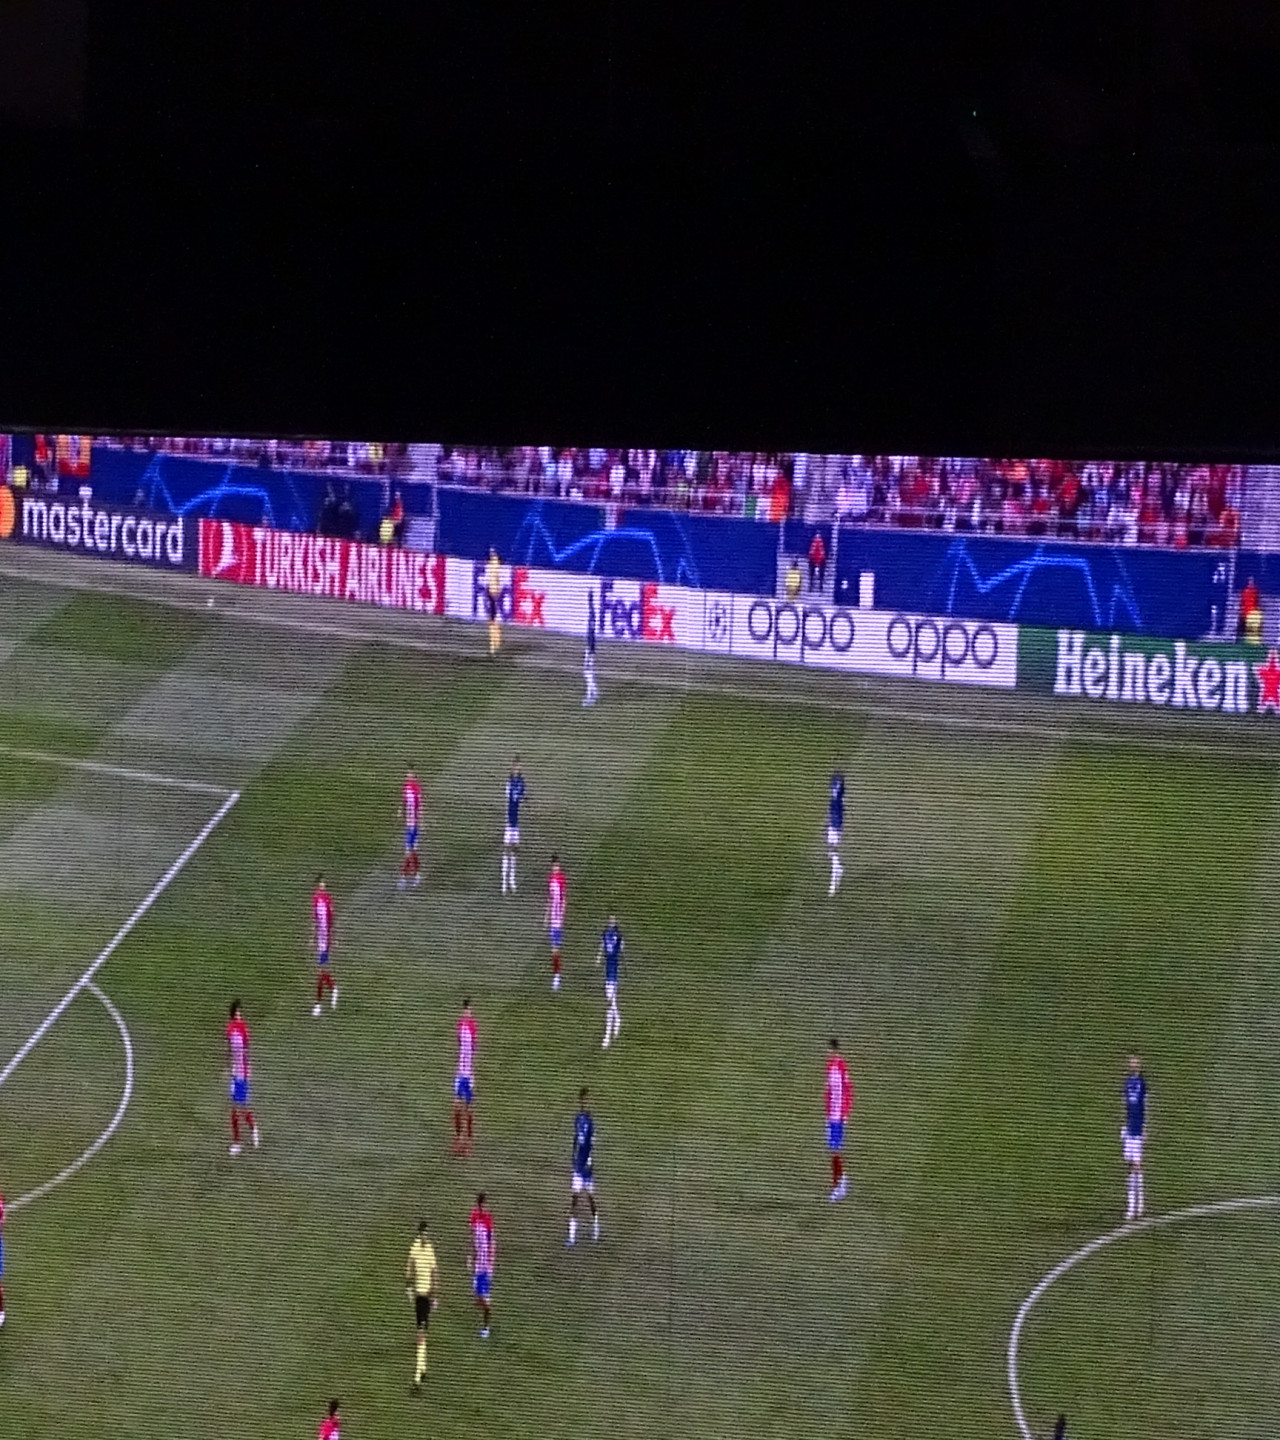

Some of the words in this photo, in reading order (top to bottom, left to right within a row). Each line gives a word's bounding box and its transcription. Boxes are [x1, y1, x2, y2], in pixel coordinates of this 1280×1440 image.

[22, 498, 183, 563] mastercard
[252, 526, 340, 600] TURKISH
[344, 541, 437, 616] AIRLINES
[600, 576, 675, 643] FedEx
[747, 600, 855, 663] oppo
[887, 614, 999, 680] oppo
[1052, 628, 1249, 713] Heineken
